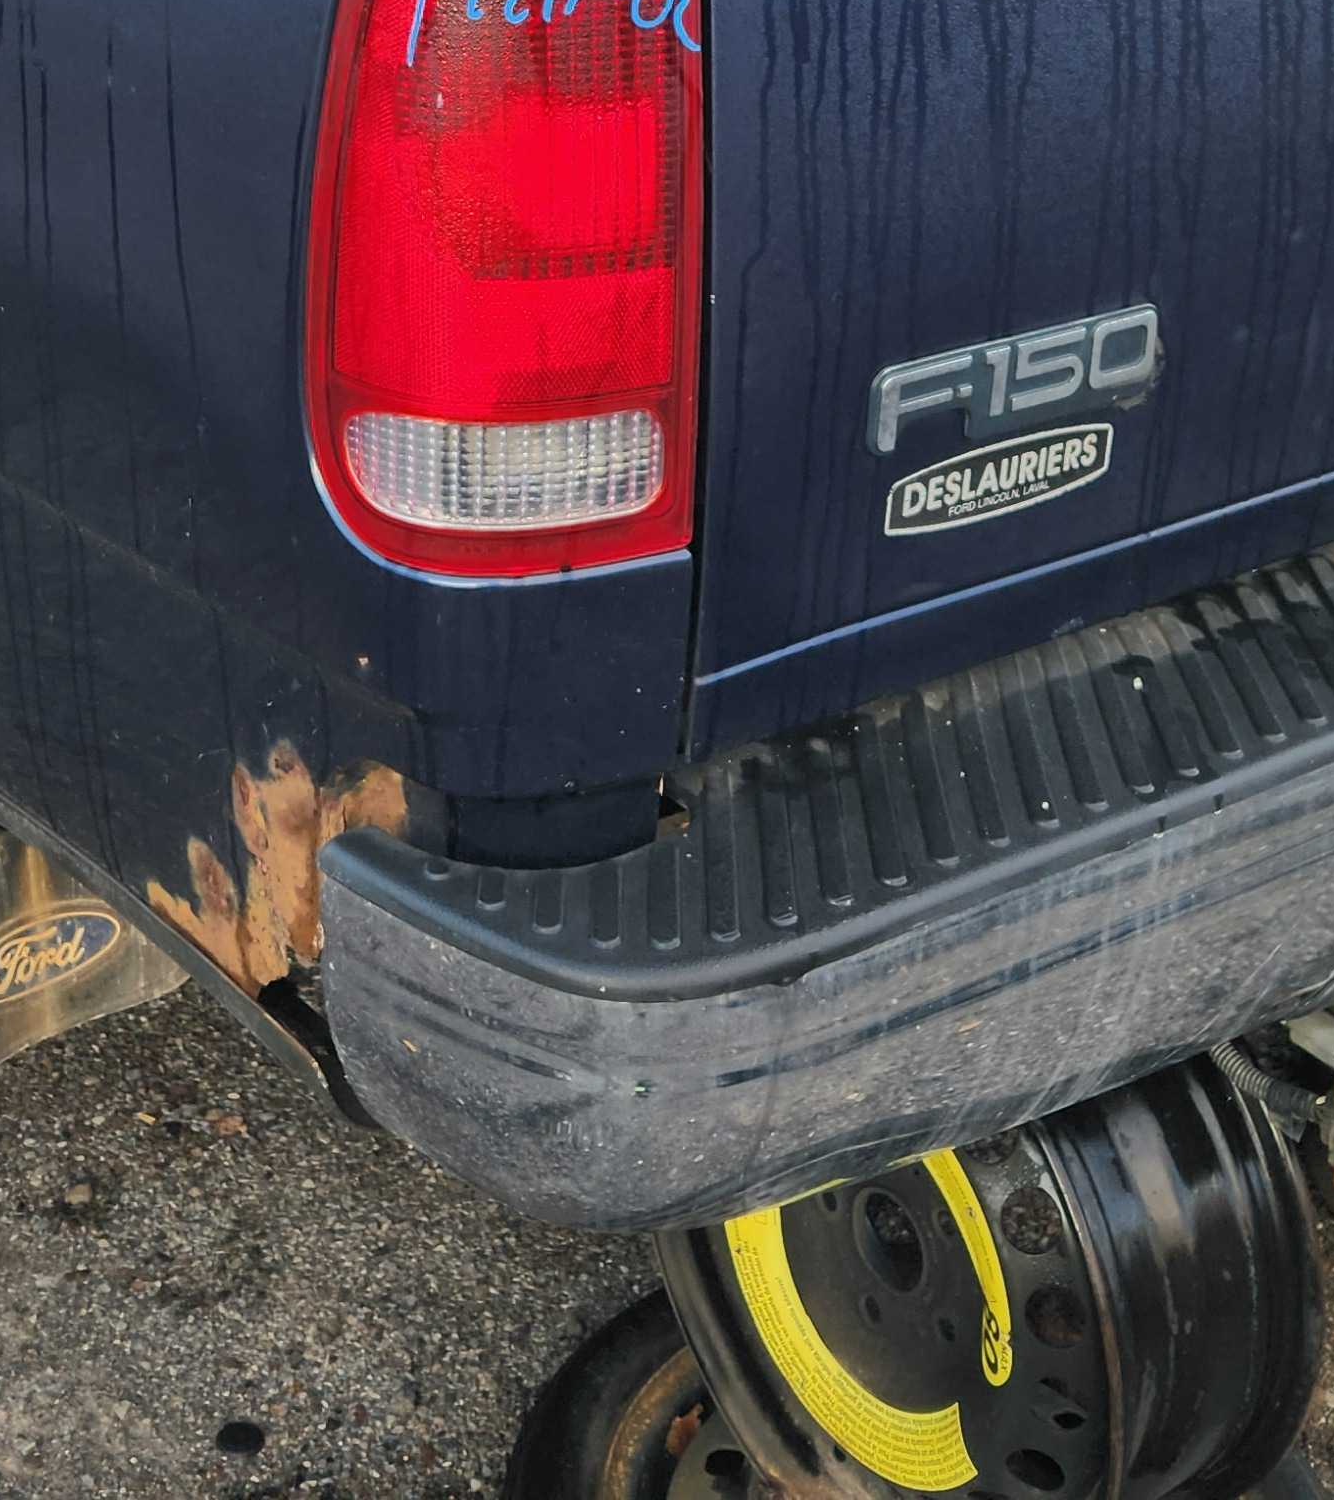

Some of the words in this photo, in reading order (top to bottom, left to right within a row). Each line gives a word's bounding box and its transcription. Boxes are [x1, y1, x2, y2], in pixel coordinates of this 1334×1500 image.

[901, 433, 1098, 518] DESLAURIERS
[947, 501, 976, 517] FORD
[1022, 480, 1051, 496] LAVAL
